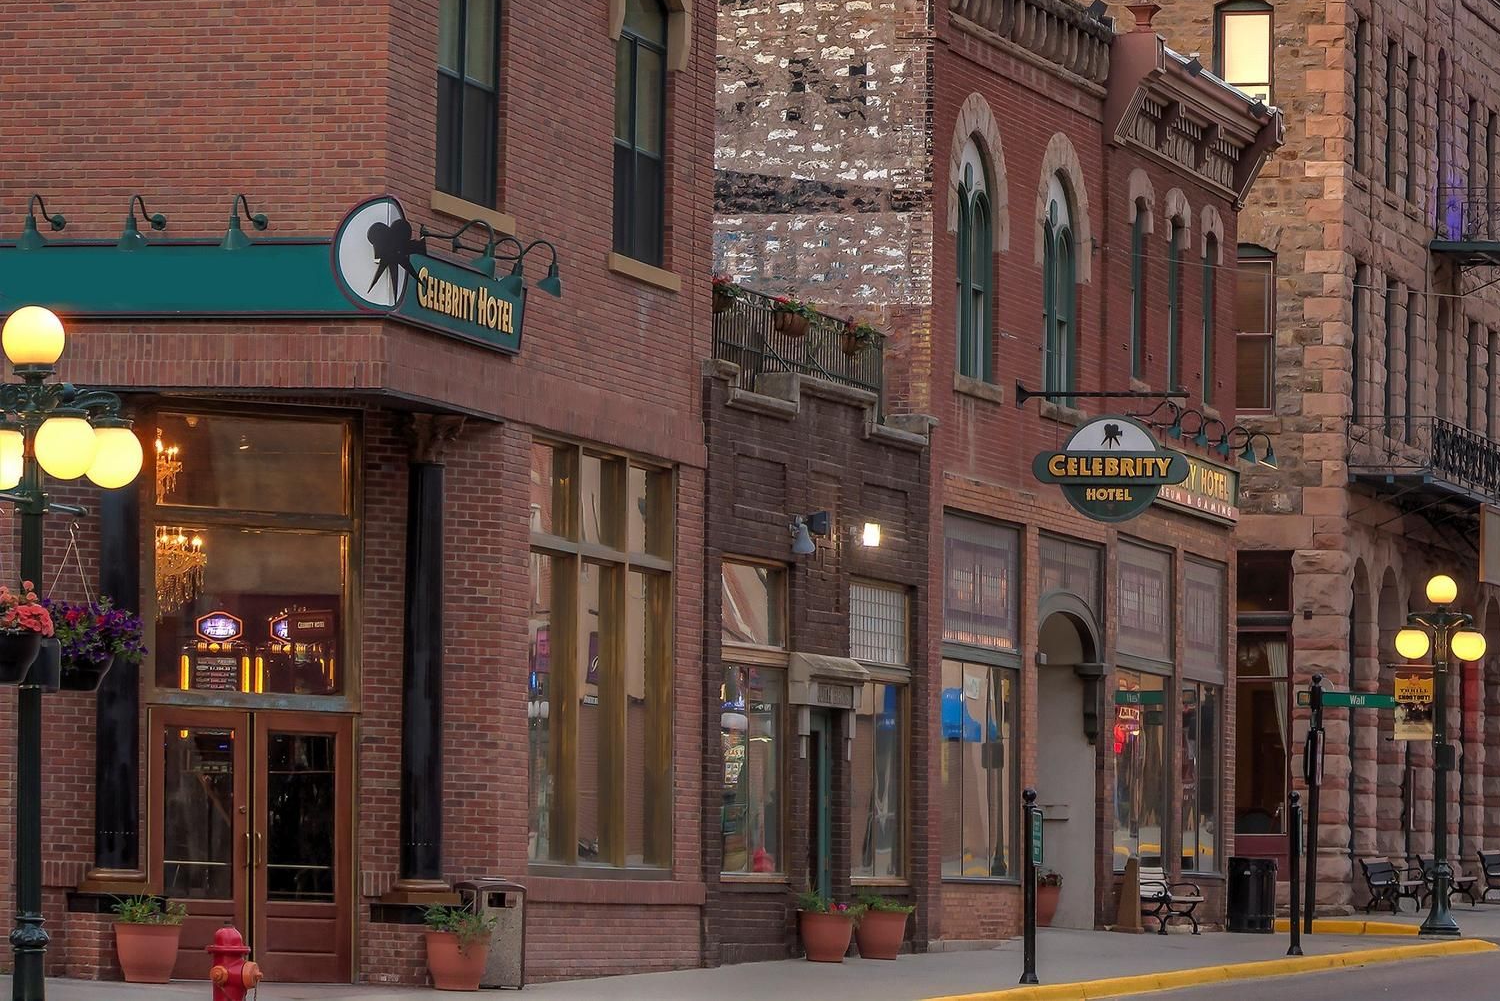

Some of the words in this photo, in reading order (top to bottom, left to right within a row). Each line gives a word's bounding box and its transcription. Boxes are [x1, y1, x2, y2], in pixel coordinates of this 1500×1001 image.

[417, 266, 476, 321] CELEBRITY
[477, 286, 514, 334] HOTEL
[1048, 454, 1171, 478] CELEBRITY
[1086, 488, 1132, 501] HOTEL
[1201, 467, 1229, 502] HOTEL
[1161, 485, 1181, 502] SEUM
[1197, 497, 1232, 517] GAMING
[1350, 695, 1365, 705] Wall
